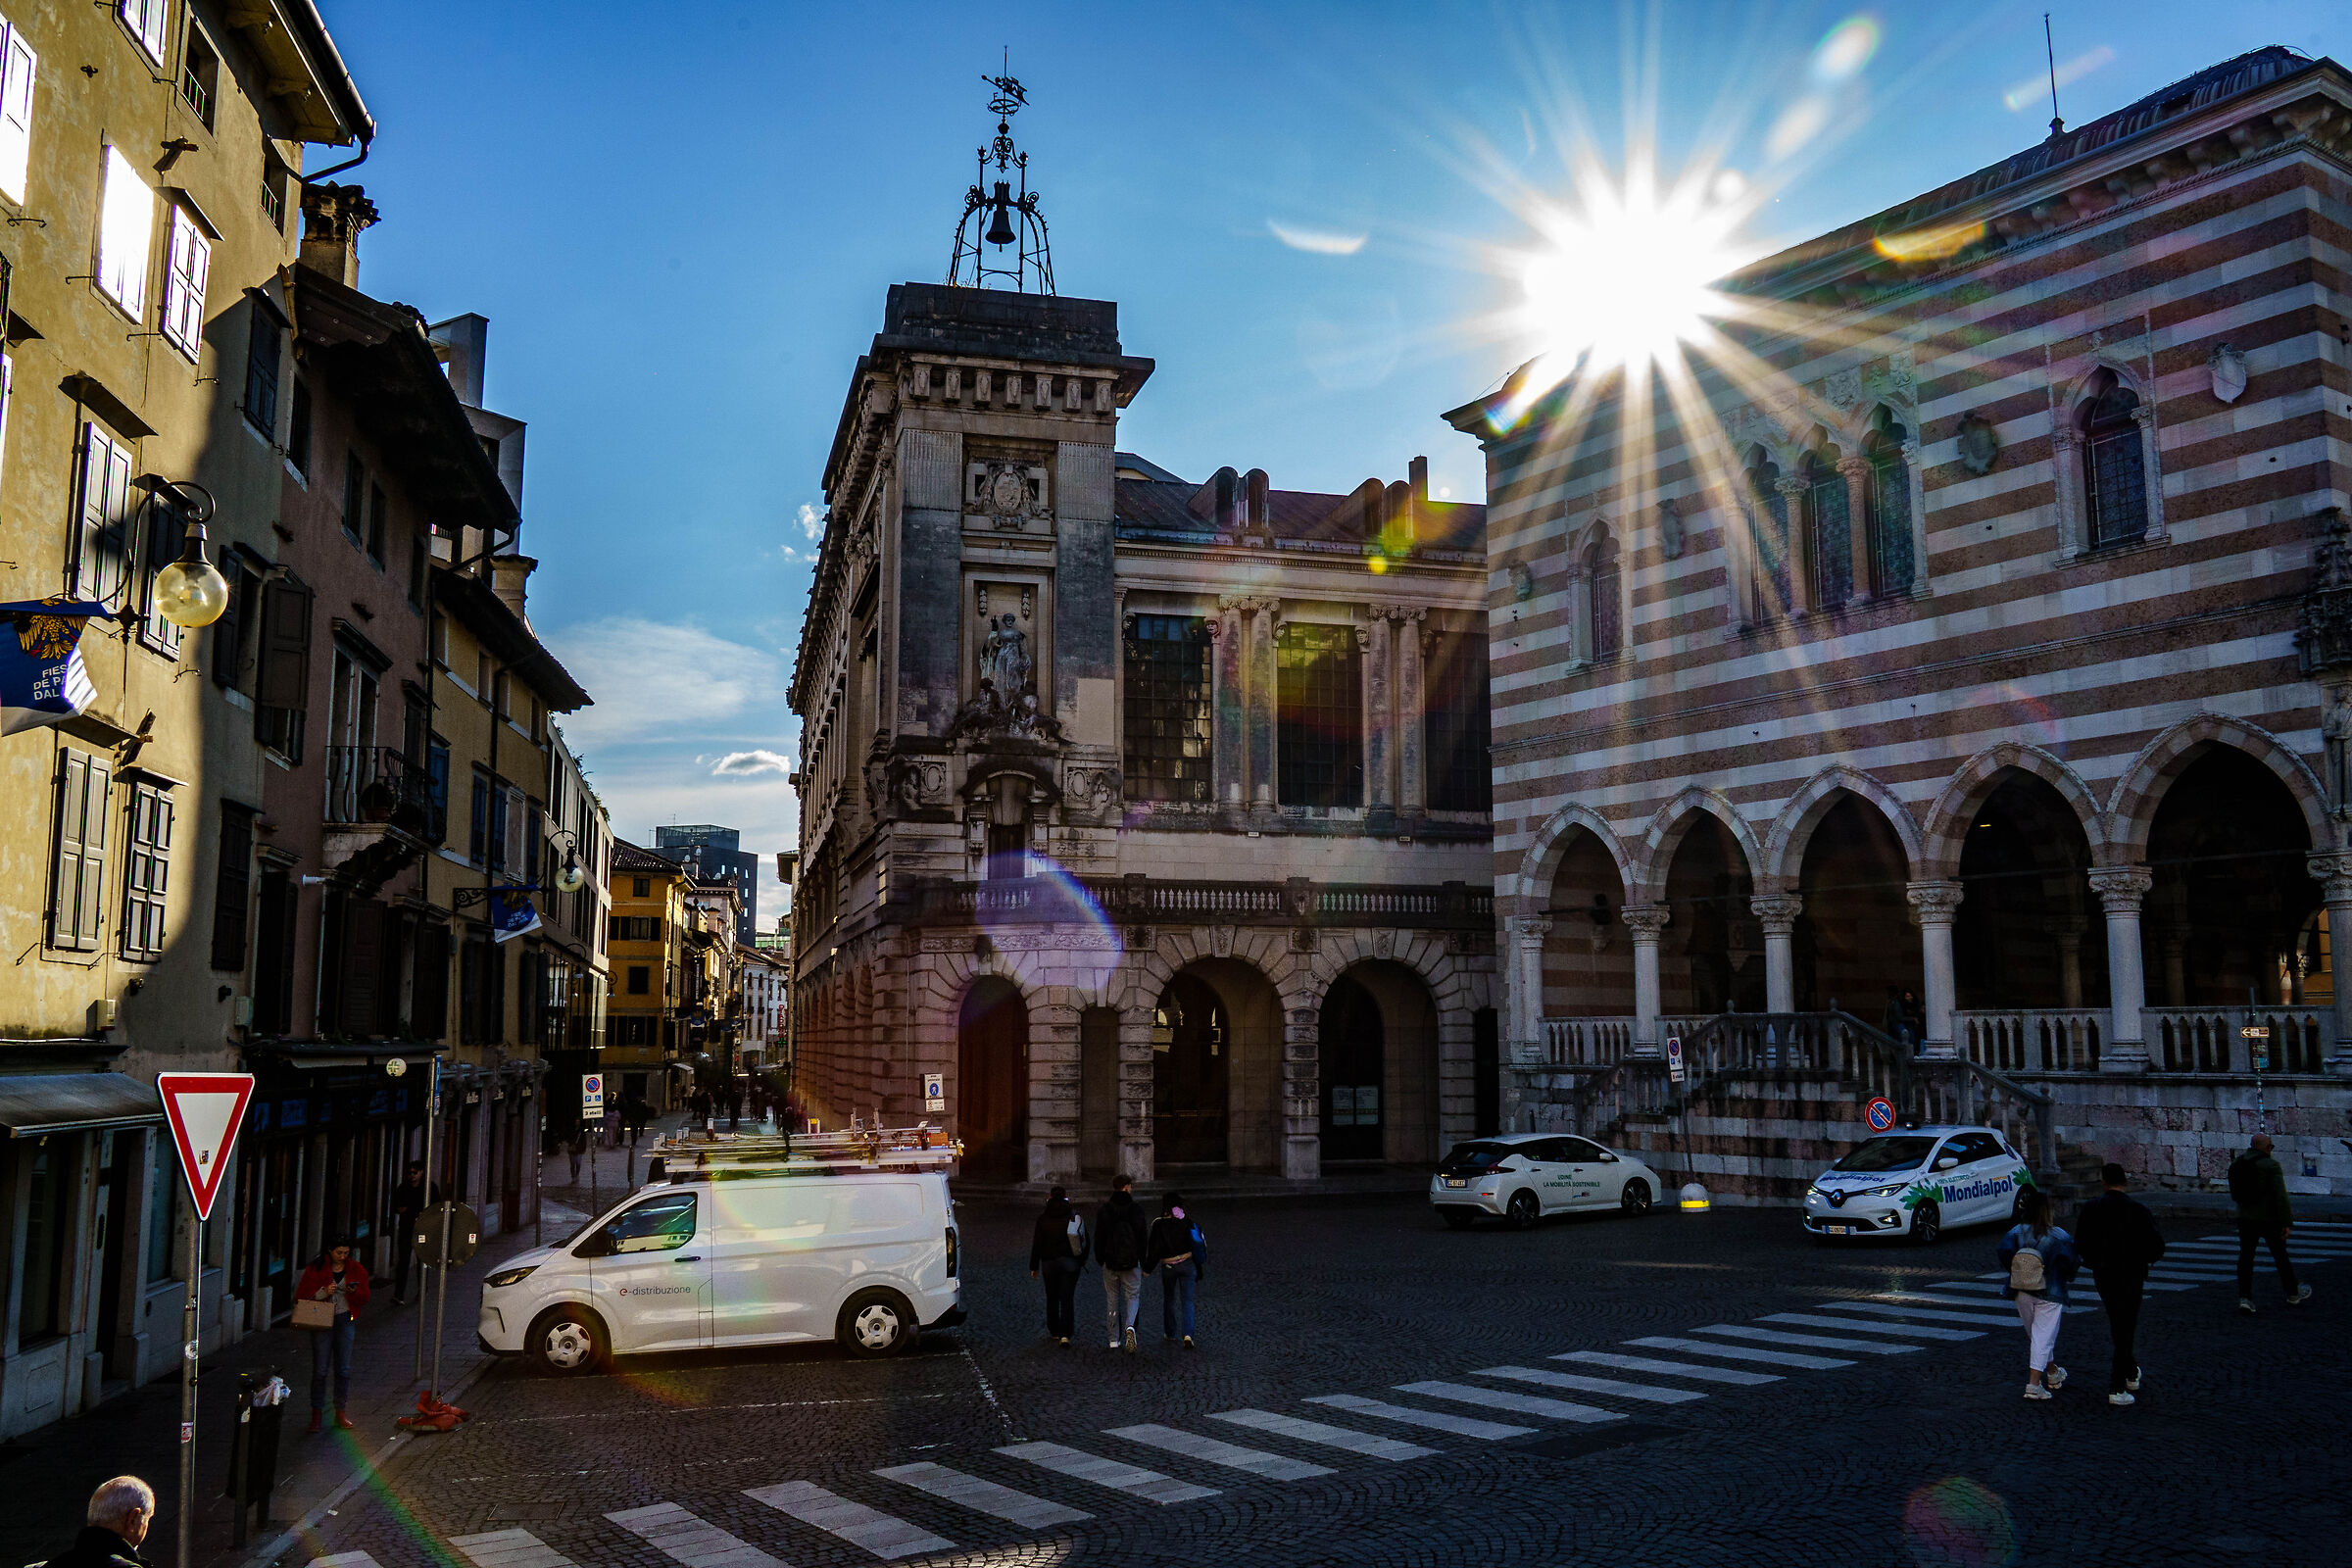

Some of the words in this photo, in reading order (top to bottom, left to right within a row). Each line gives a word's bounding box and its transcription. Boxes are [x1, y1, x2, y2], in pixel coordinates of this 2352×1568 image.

[33, 678, 50, 690] DE
[34, 689, 60, 701] DAL
[1820, 1174, 1886, 1183] Mondialpol
[1943, 1175, 2013, 1203] Mondialpol
[619, 1286, 691, 1297] e-distribuzione
